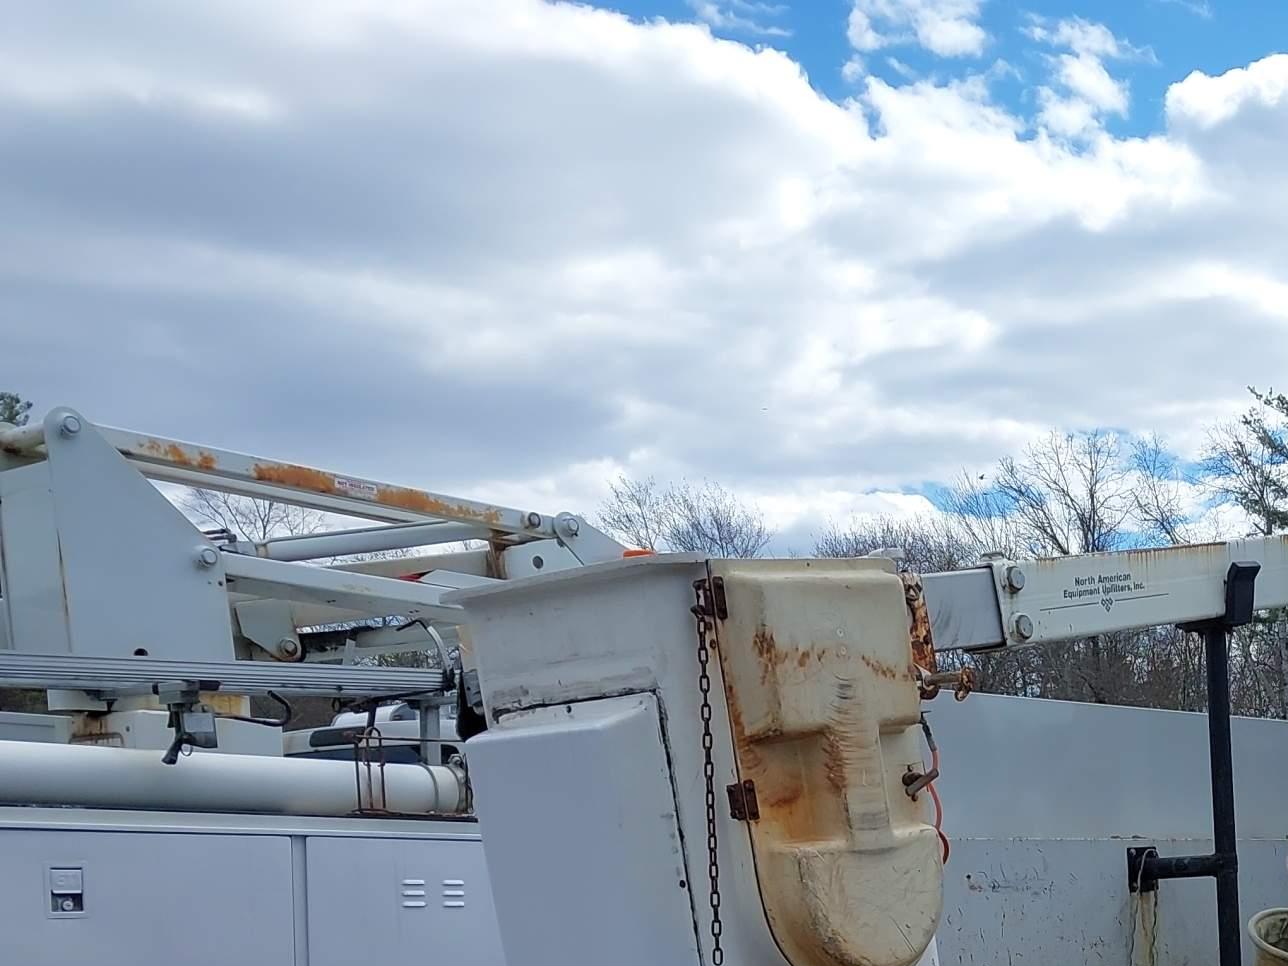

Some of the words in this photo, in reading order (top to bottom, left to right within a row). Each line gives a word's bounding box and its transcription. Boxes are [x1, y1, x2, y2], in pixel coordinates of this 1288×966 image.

[1074, 575, 1096, 587] North
[1098, 572, 1131, 584] American
[1063, 587, 1100, 600] Equipment
[1133, 582, 1145, 591] Inc.
